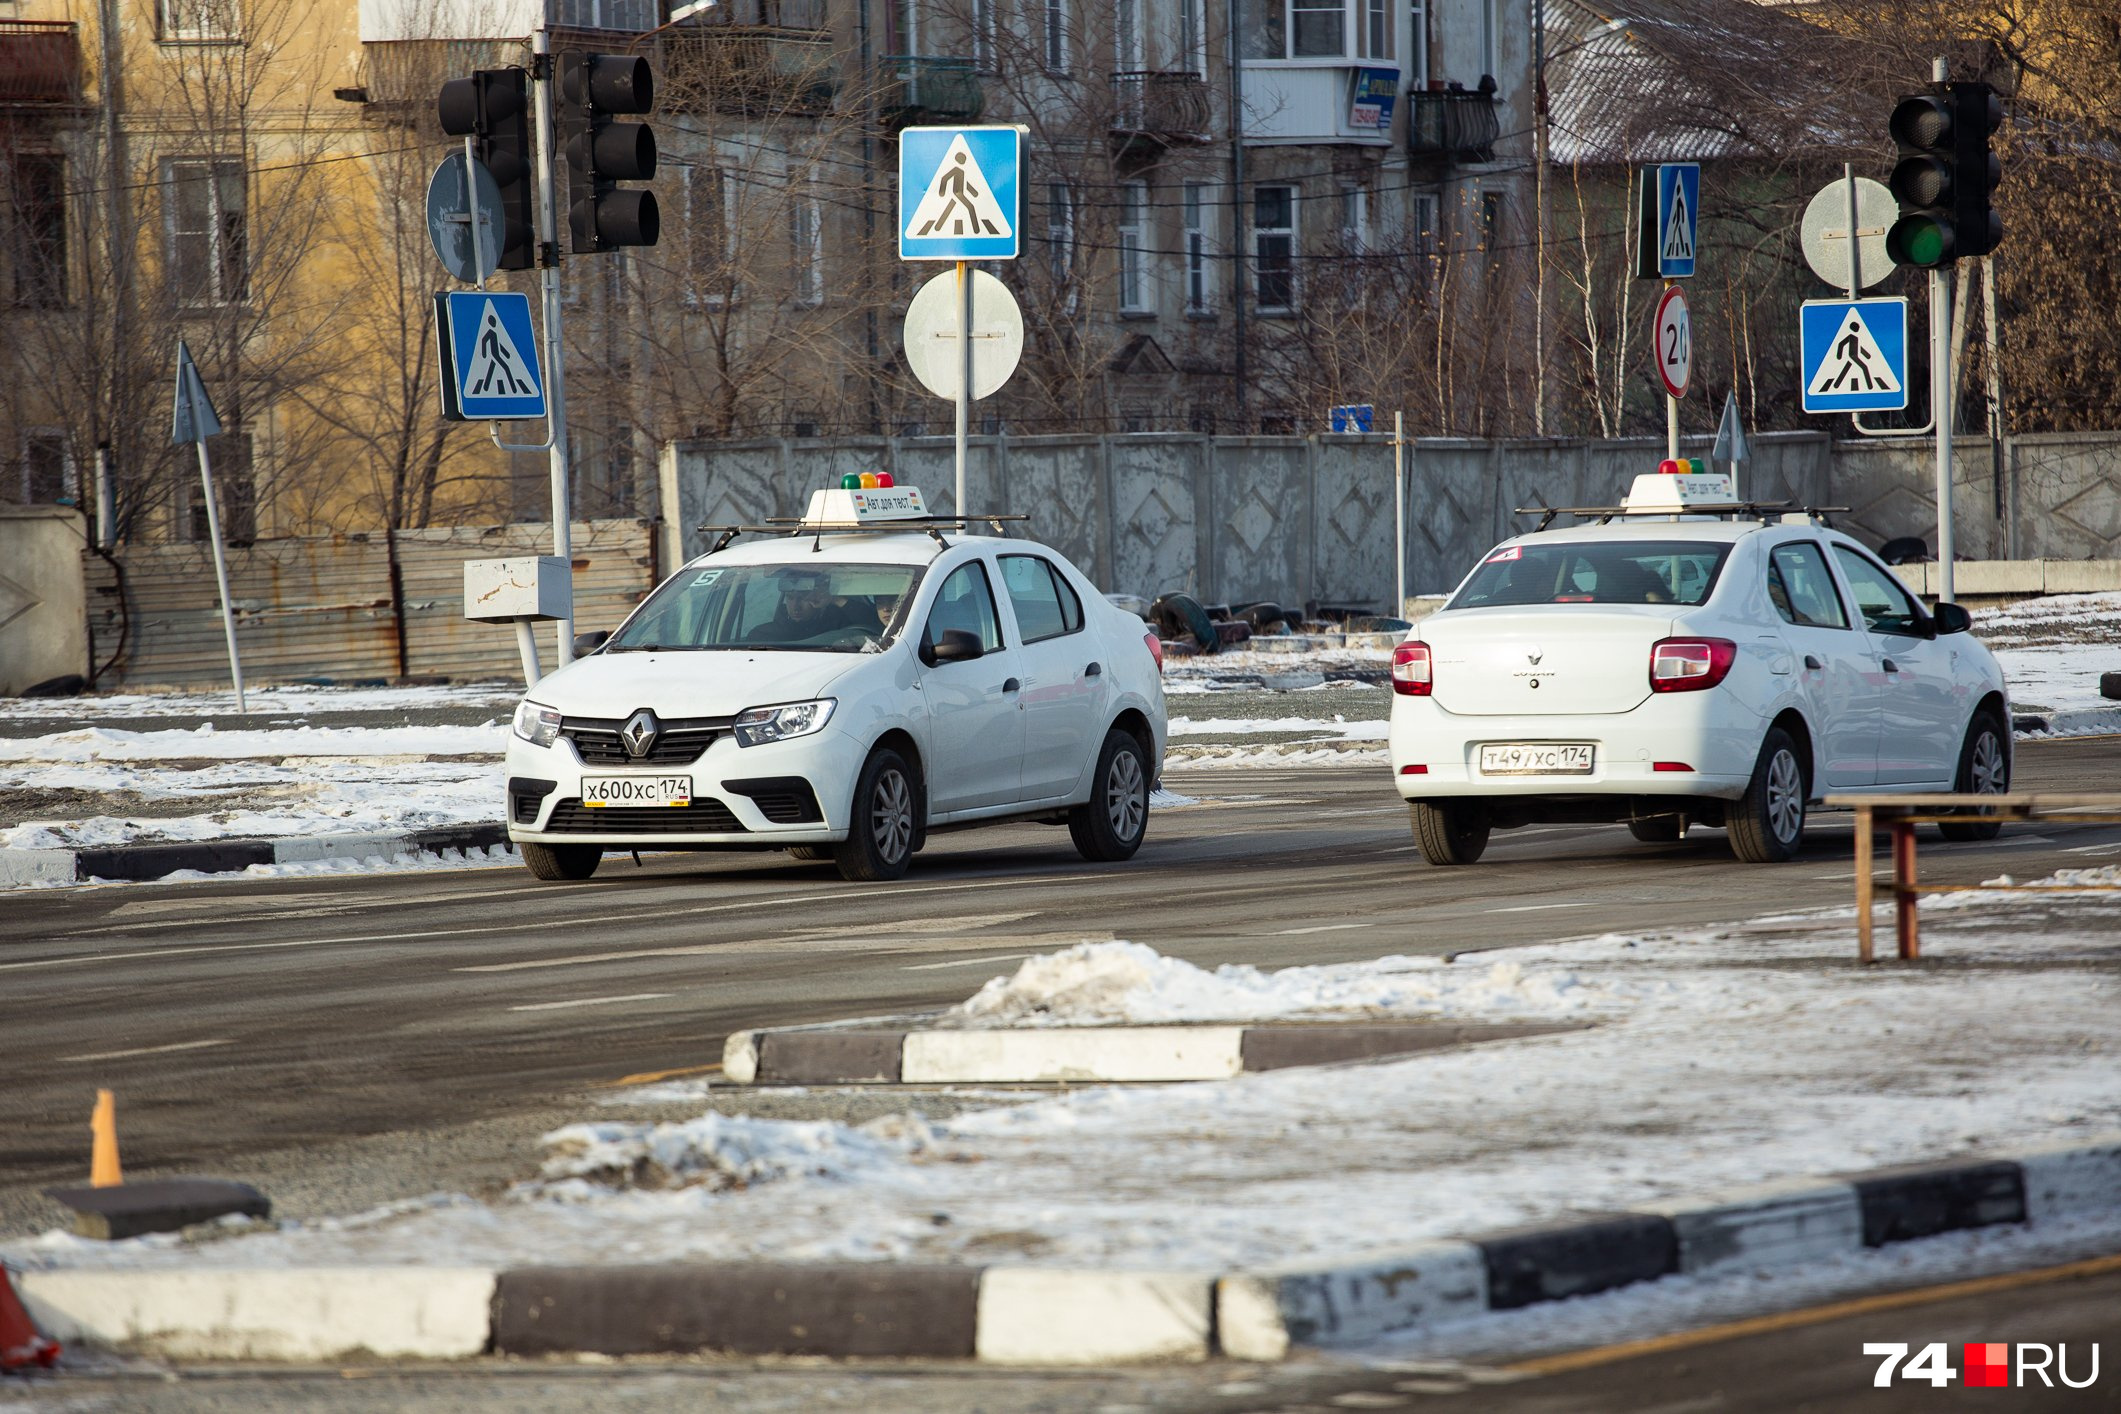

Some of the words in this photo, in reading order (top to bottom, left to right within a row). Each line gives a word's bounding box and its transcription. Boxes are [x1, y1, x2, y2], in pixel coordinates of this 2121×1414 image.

[1666, 322, 1687, 365] 20
[694, 572, 719, 584] 5
[1561, 748, 1588, 762] 174
[588, 781, 655, 799] Х600ХС
[660, 780, 686, 794] 174
